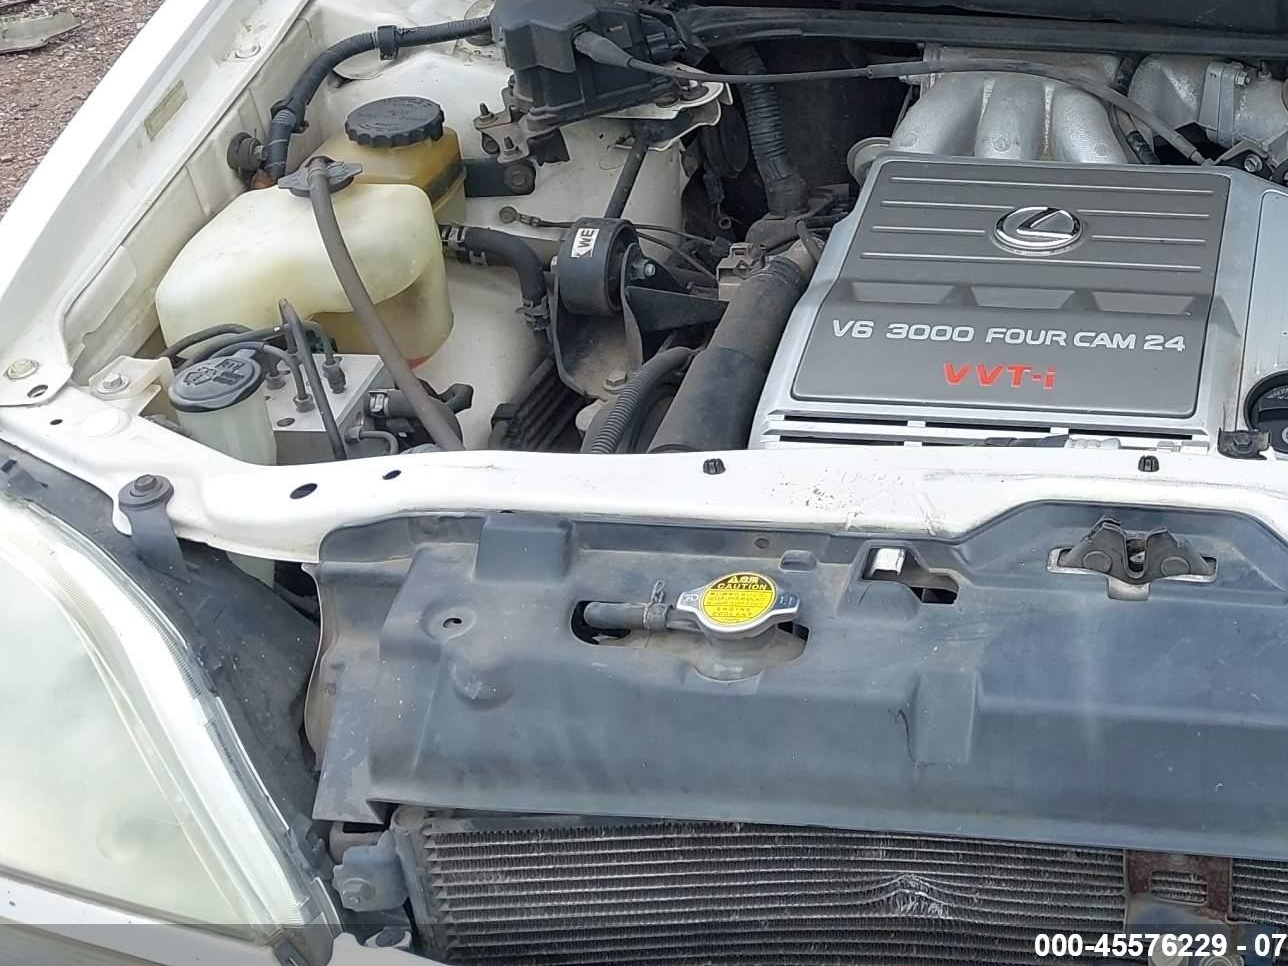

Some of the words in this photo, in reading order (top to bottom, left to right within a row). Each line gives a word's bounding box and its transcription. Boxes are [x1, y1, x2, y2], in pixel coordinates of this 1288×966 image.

[832, 319, 875, 338] V6
[886, 323, 975, 342] 3000
[985, 328, 1067, 347] FOUR
[1073, 332, 1137, 350] CAM
[1143, 335, 1186, 352] 24
[943, 361, 1057, 390] VVT-i
[717, 583, 768, 591] CAUTION
